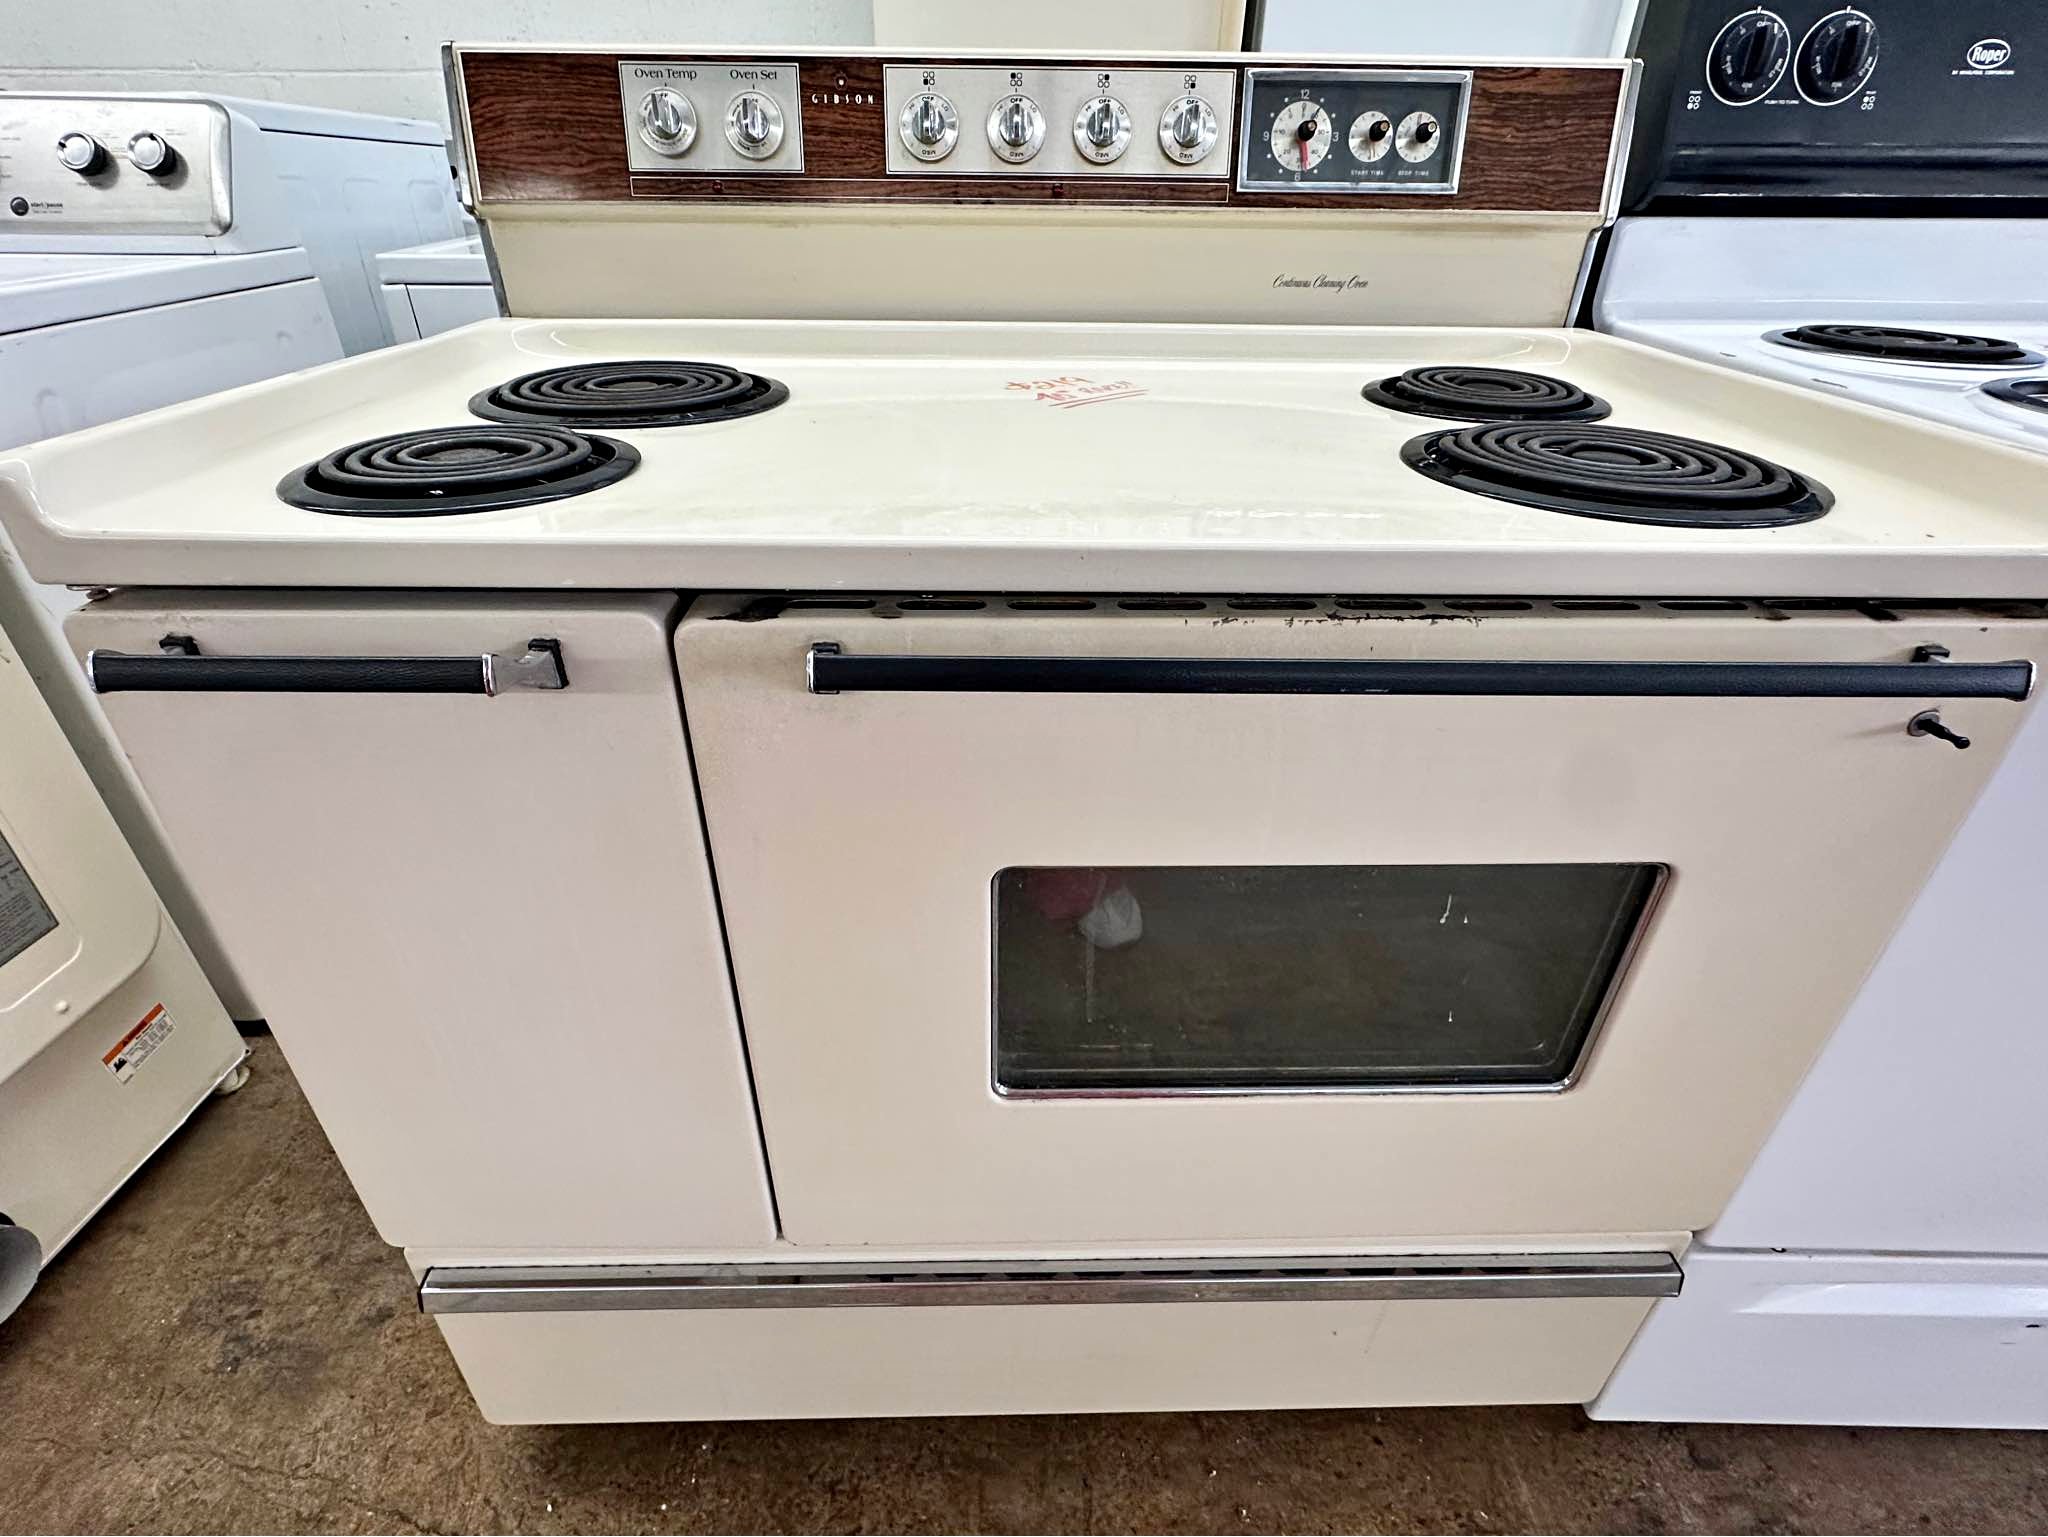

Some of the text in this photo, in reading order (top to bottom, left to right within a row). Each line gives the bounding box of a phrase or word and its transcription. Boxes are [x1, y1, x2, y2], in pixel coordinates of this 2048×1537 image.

[1971, 46, 2007, 64] Roper
[634, 68, 698, 81] Oven Temp
[729, 69, 778, 80] Oven Set
[811, 93, 875, 105] GIBSON
[1300, 89, 1310, 99] 12
[941, 103, 949, 111] LO
[1029, 104, 1038, 113] LO
[1117, 106, 1126, 115] LO
[1204, 107, 1213, 117] LO
[1263, 131, 1270, 142] 9
[1332, 131, 1339, 142] 3
[1294, 172, 1301, 181] 6
